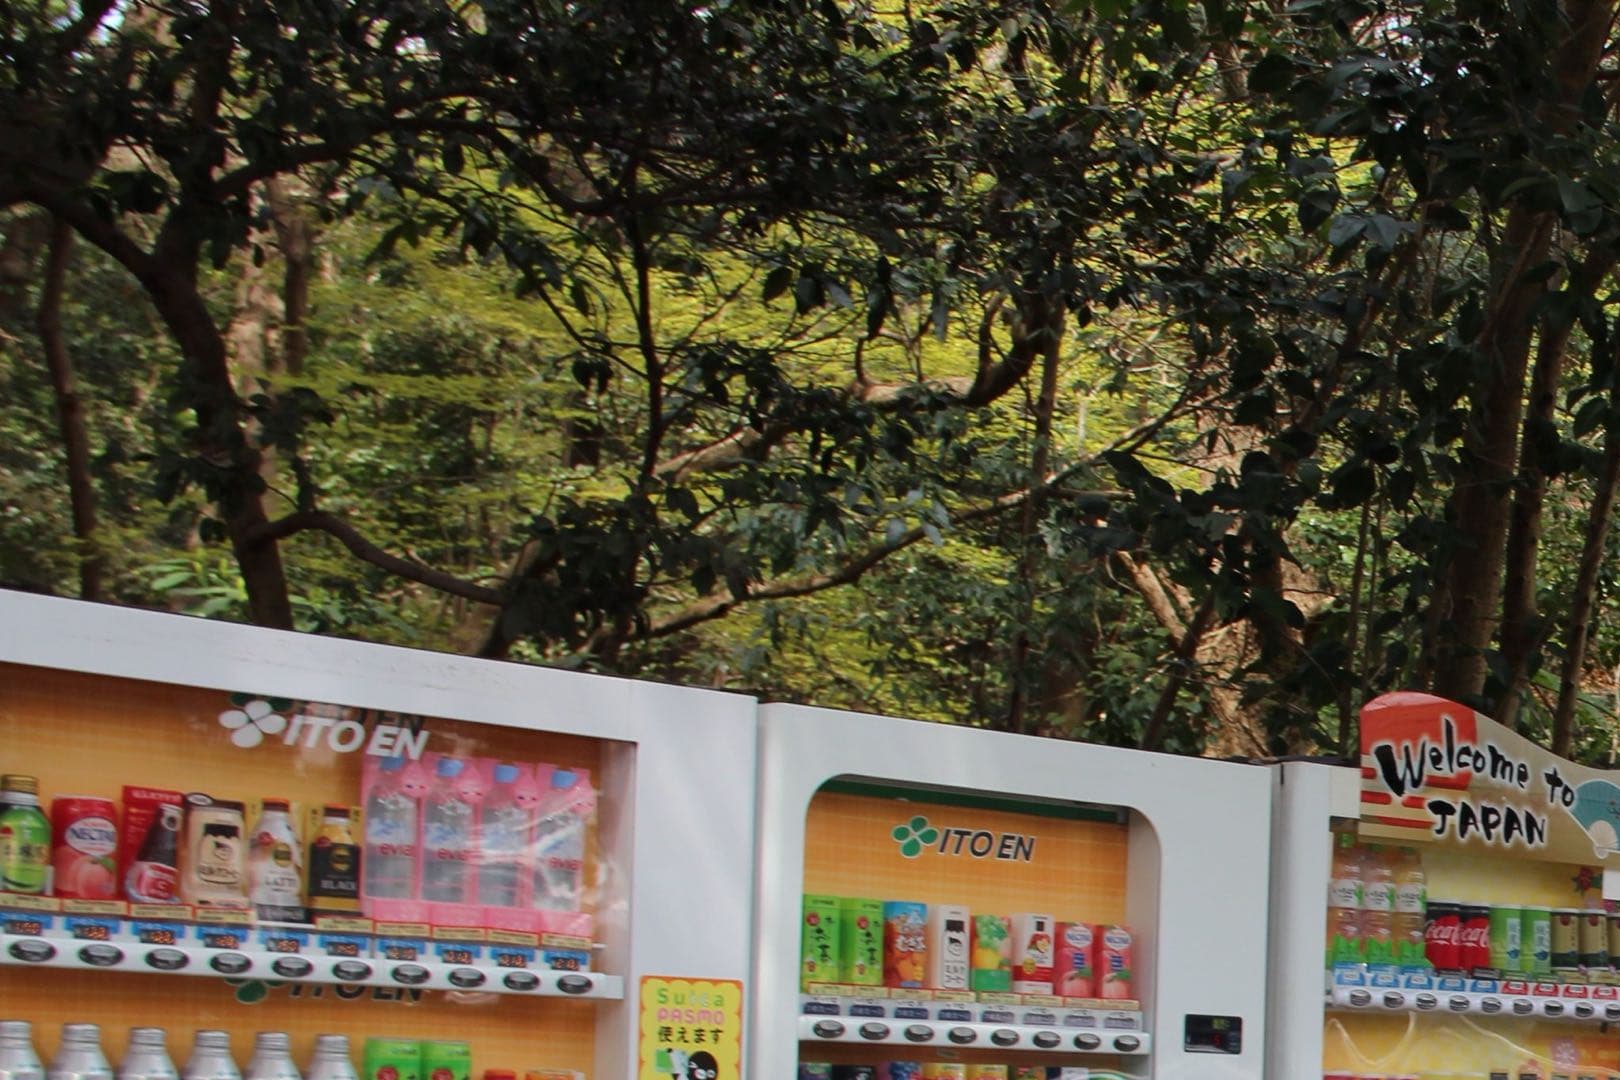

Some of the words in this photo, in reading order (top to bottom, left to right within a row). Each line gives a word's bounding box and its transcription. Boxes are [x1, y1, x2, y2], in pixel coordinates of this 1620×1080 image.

[284, 714, 365, 754] ITO
[366, 724, 430, 761] EN
[1375, 717, 1530, 797] Welcome
[1545, 768, 1574, 807] to
[1427, 800, 1546, 844] JAPAN
[939, 828, 993, 856] ITO
[997, 833, 1036, 864] EN
[656, 987, 725, 1008] Suica
[656, 1008, 725, 1026] PASMO
[657, 1026, 724, 1045] 使えます
